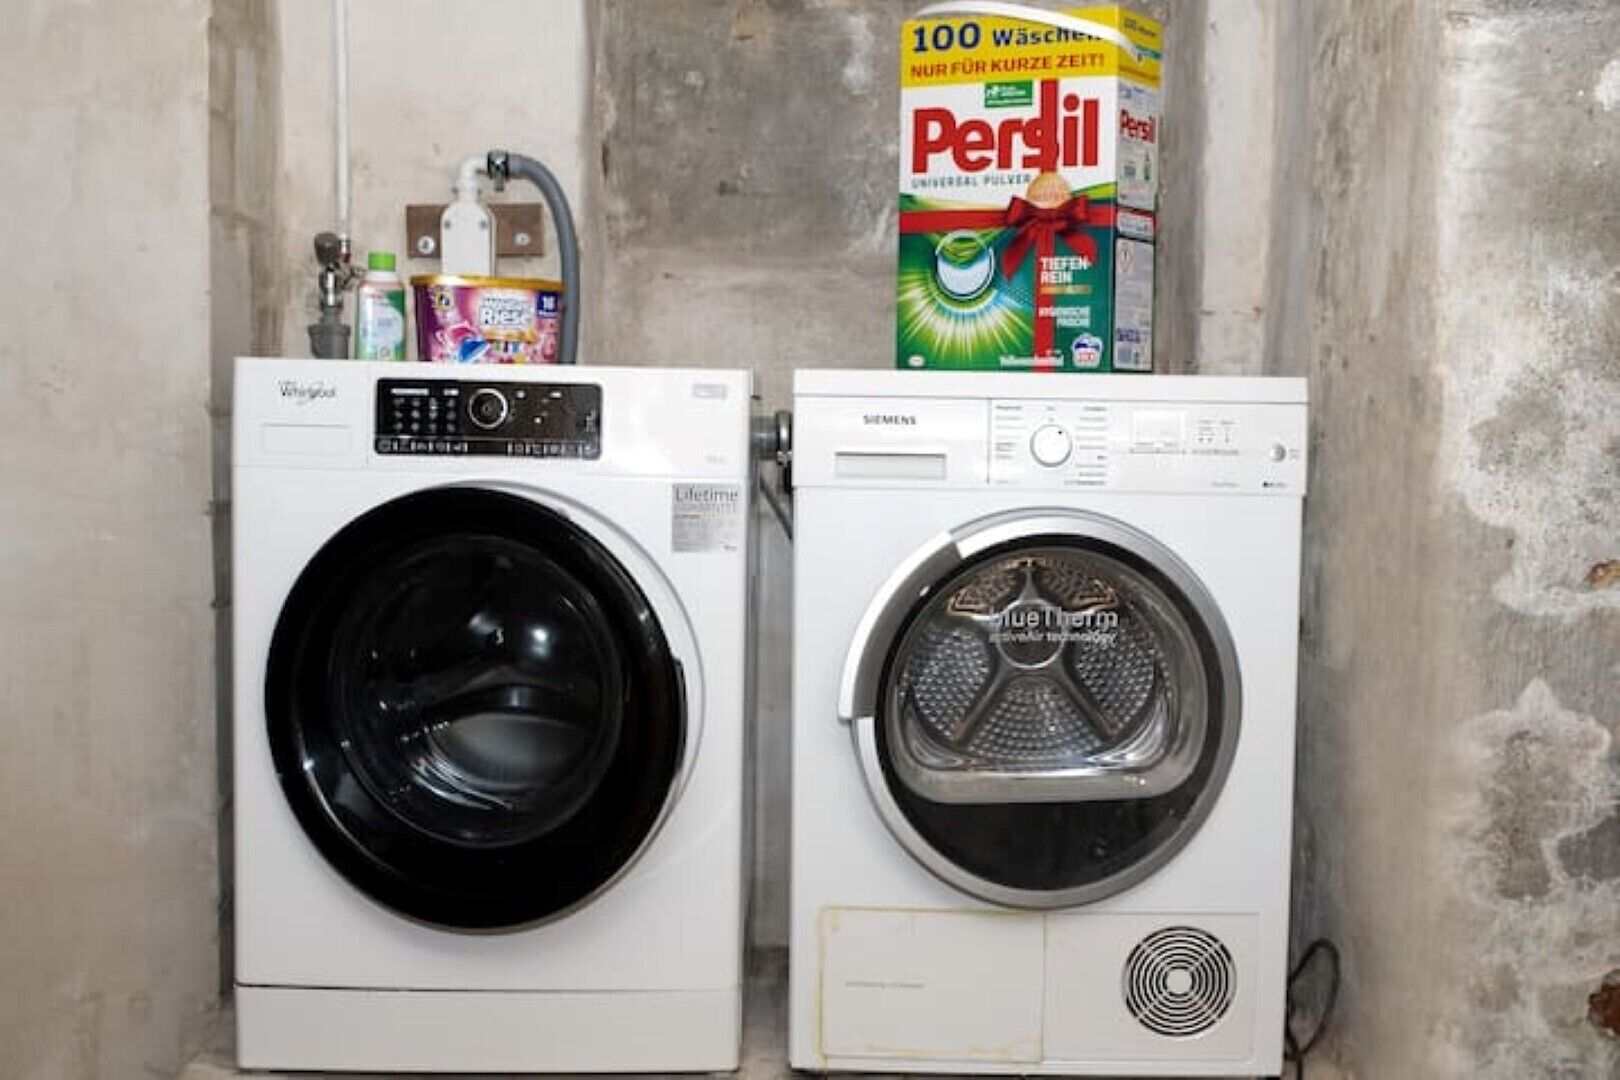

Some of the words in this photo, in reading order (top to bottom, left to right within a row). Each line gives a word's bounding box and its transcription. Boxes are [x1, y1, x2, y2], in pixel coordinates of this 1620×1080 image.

[913, 23, 982, 52] 100
[911, 62, 948, 79] NUR
[951, 57, 986, 75] FÜR
[990, 56, 1051, 73] KURZE
[1056, 52, 1105, 69] ZEIT!
[911, 92, 1100, 174] Persil
[911, 176, 978, 189] UNIVERSAL
[983, 172, 1031, 186] PULVER
[1040, 270, 1073, 284] REIN
[278, 380, 336, 400] Whirlpool
[862, 414, 917, 426] SIEMENS
[675, 485, 739, 501] Lifetime
